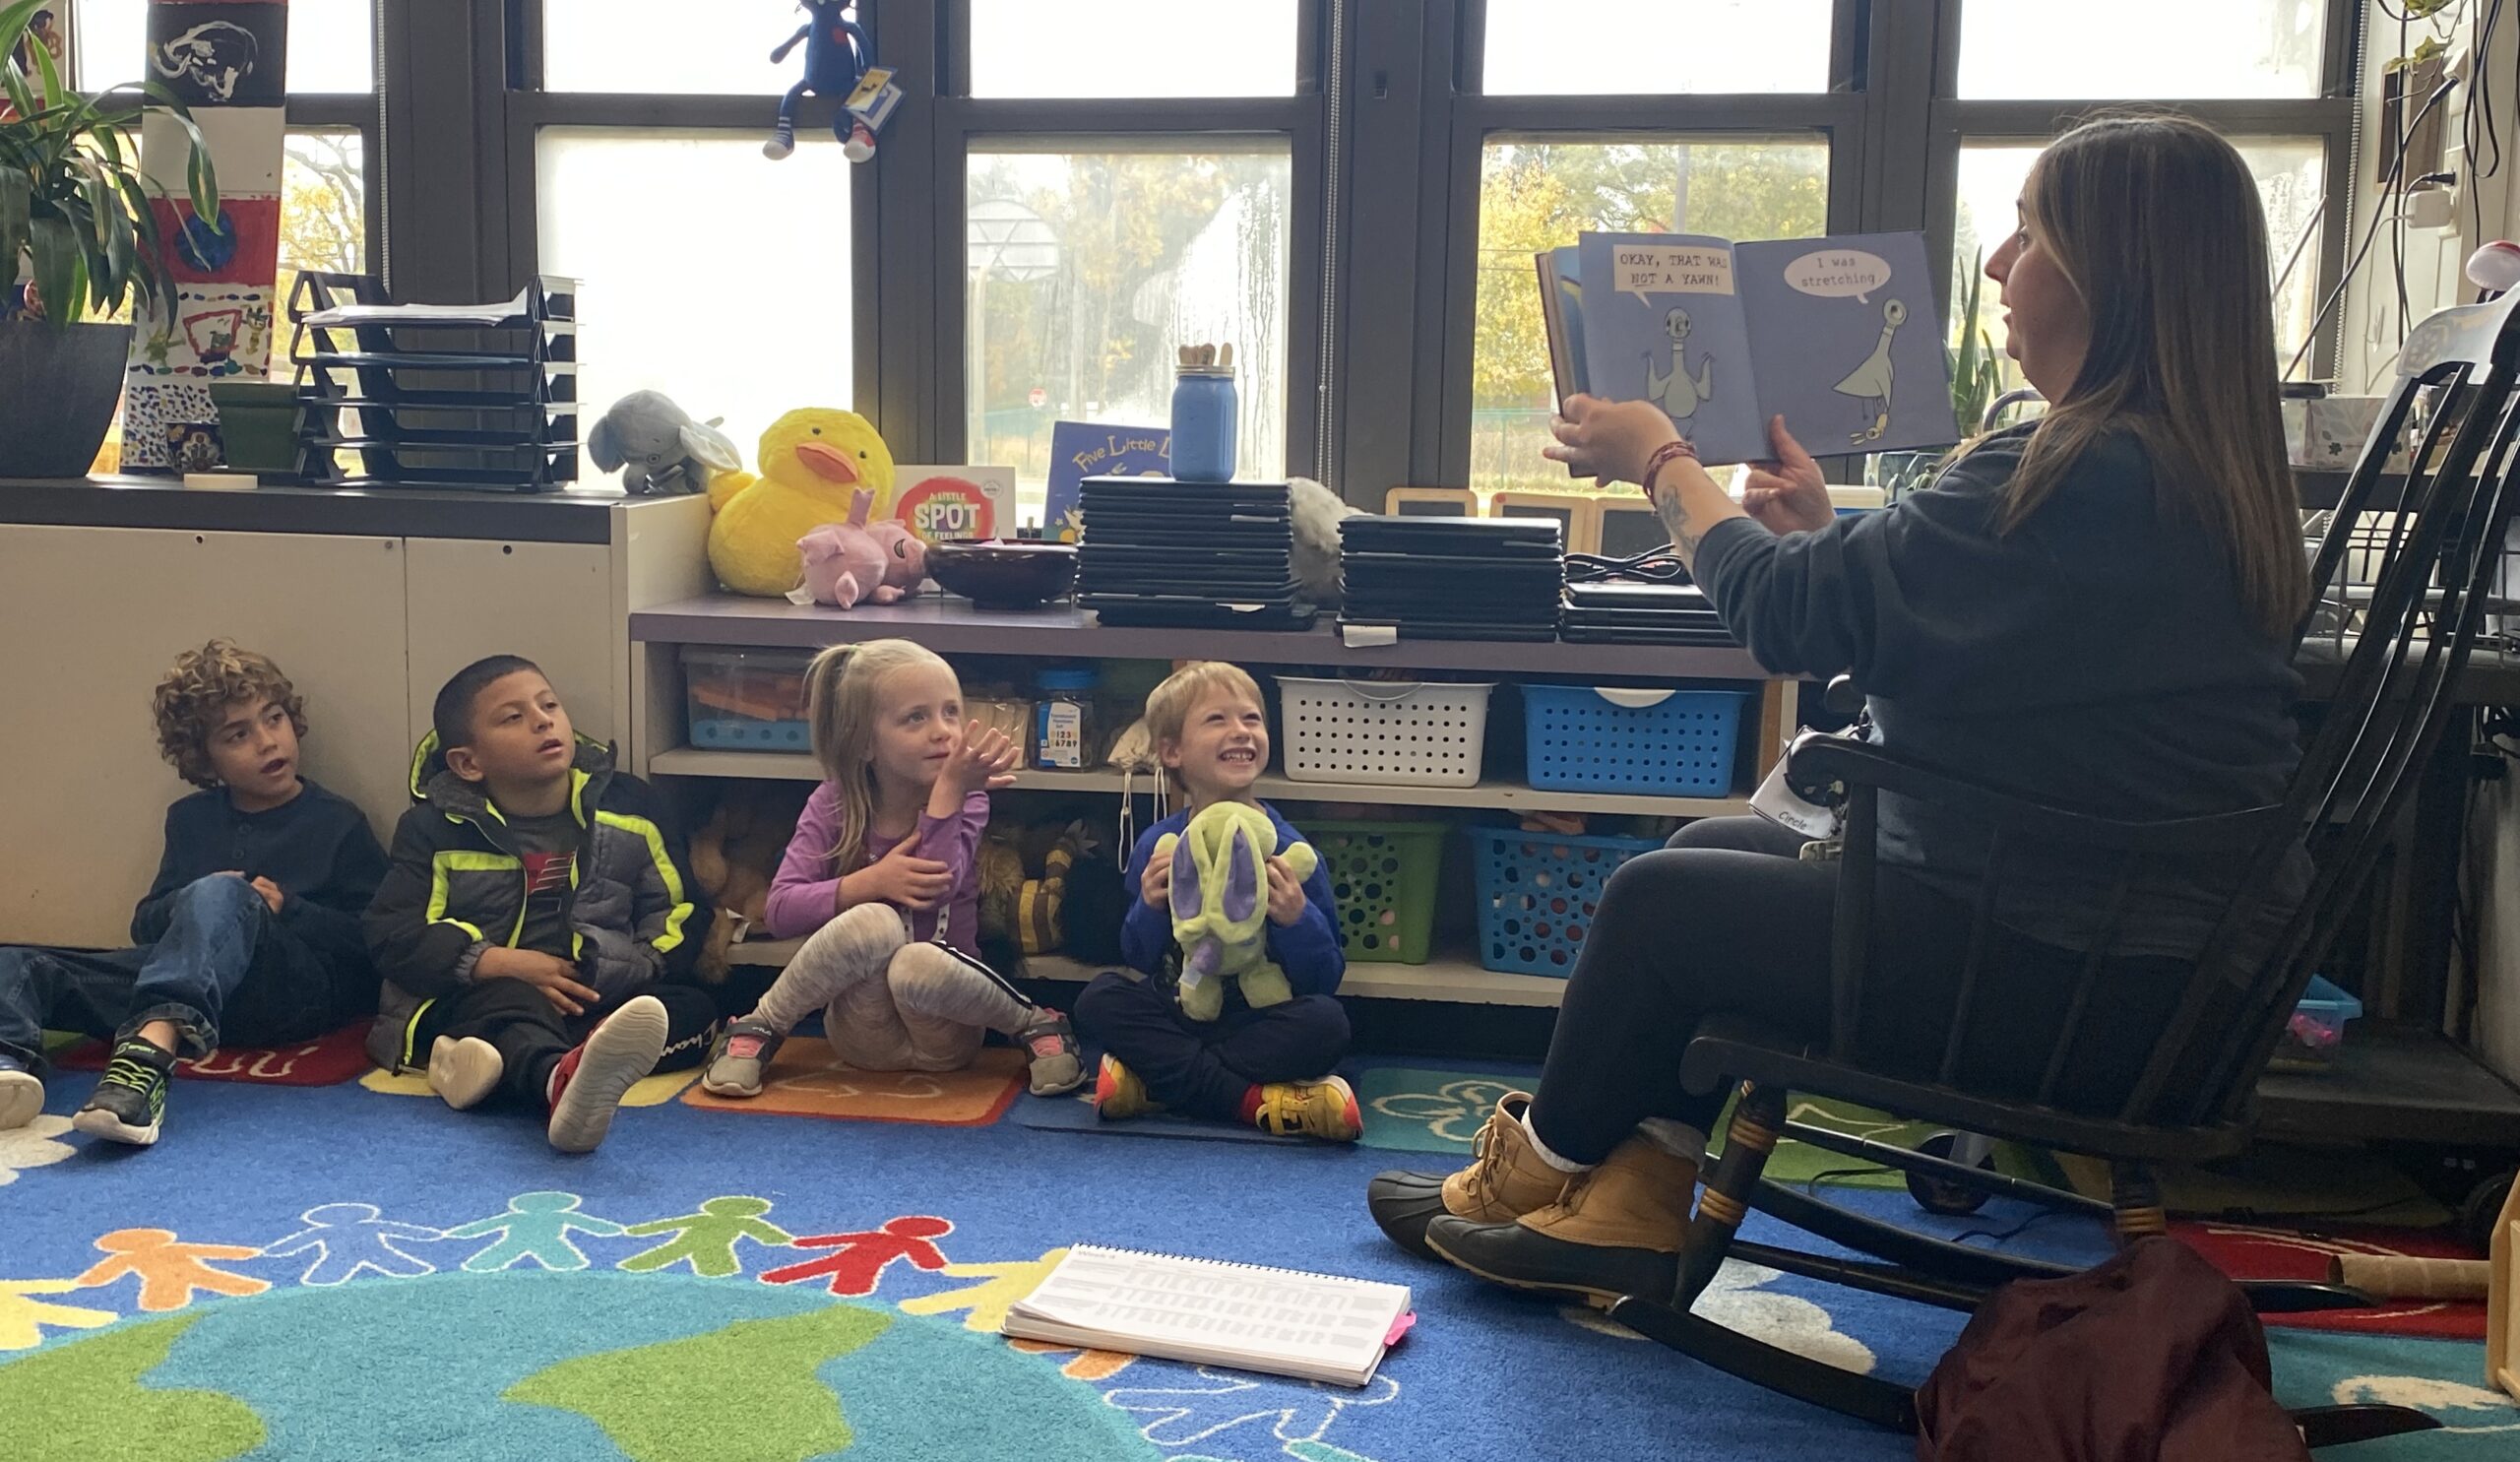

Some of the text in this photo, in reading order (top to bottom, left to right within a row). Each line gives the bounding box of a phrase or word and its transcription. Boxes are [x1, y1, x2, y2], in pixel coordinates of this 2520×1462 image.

[1619, 254, 1660, 268] OKAY,
[1669, 255, 1701, 267] THAT
[1817, 257, 1857, 268] I was
[1630, 273, 1719, 286] NOT A YAWN!
[1072, 447, 1106, 474] Five
[1106, 435, 1156, 457] Little
[928, 491, 967, 501] A LITTLE
[914, 502, 981, 531] SPOT
[1778, 810, 1808, 831] Circle
